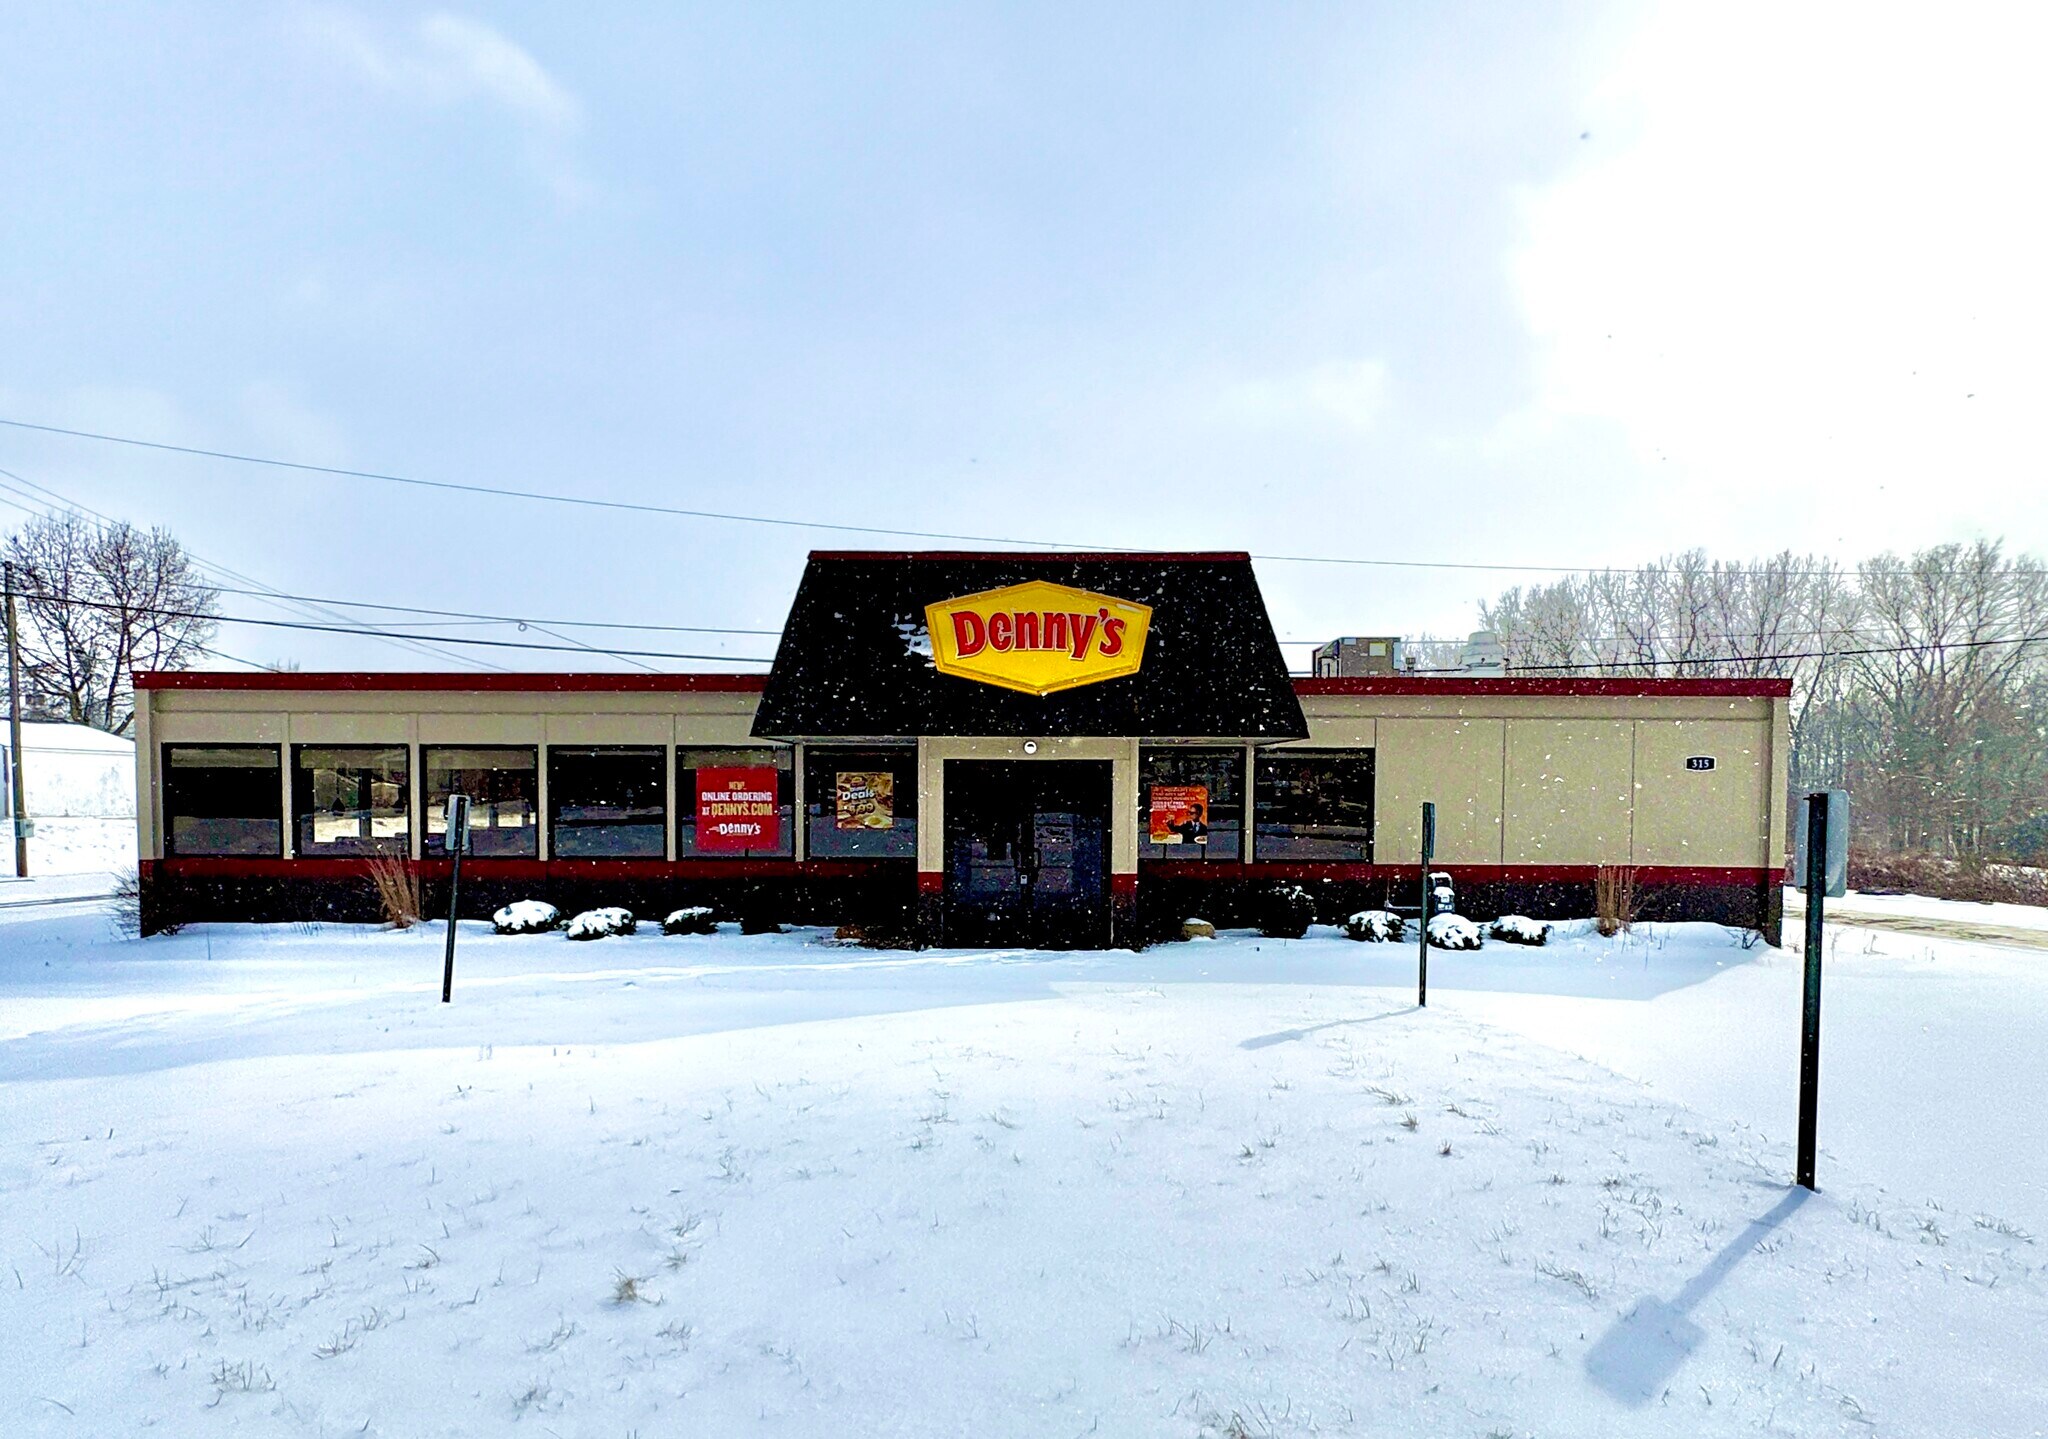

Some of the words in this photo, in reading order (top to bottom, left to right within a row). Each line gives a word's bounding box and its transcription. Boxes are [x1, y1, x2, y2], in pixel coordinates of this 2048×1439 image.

[950, 607, 1125, 661] Denny's
[1691, 759, 1710, 769] 315
[701, 791, 731, 802] ONLINE
[731, 791, 773, 802] ORDERING
[841, 789, 875, 801] Deals
[718, 822, 762, 836] Denny's
